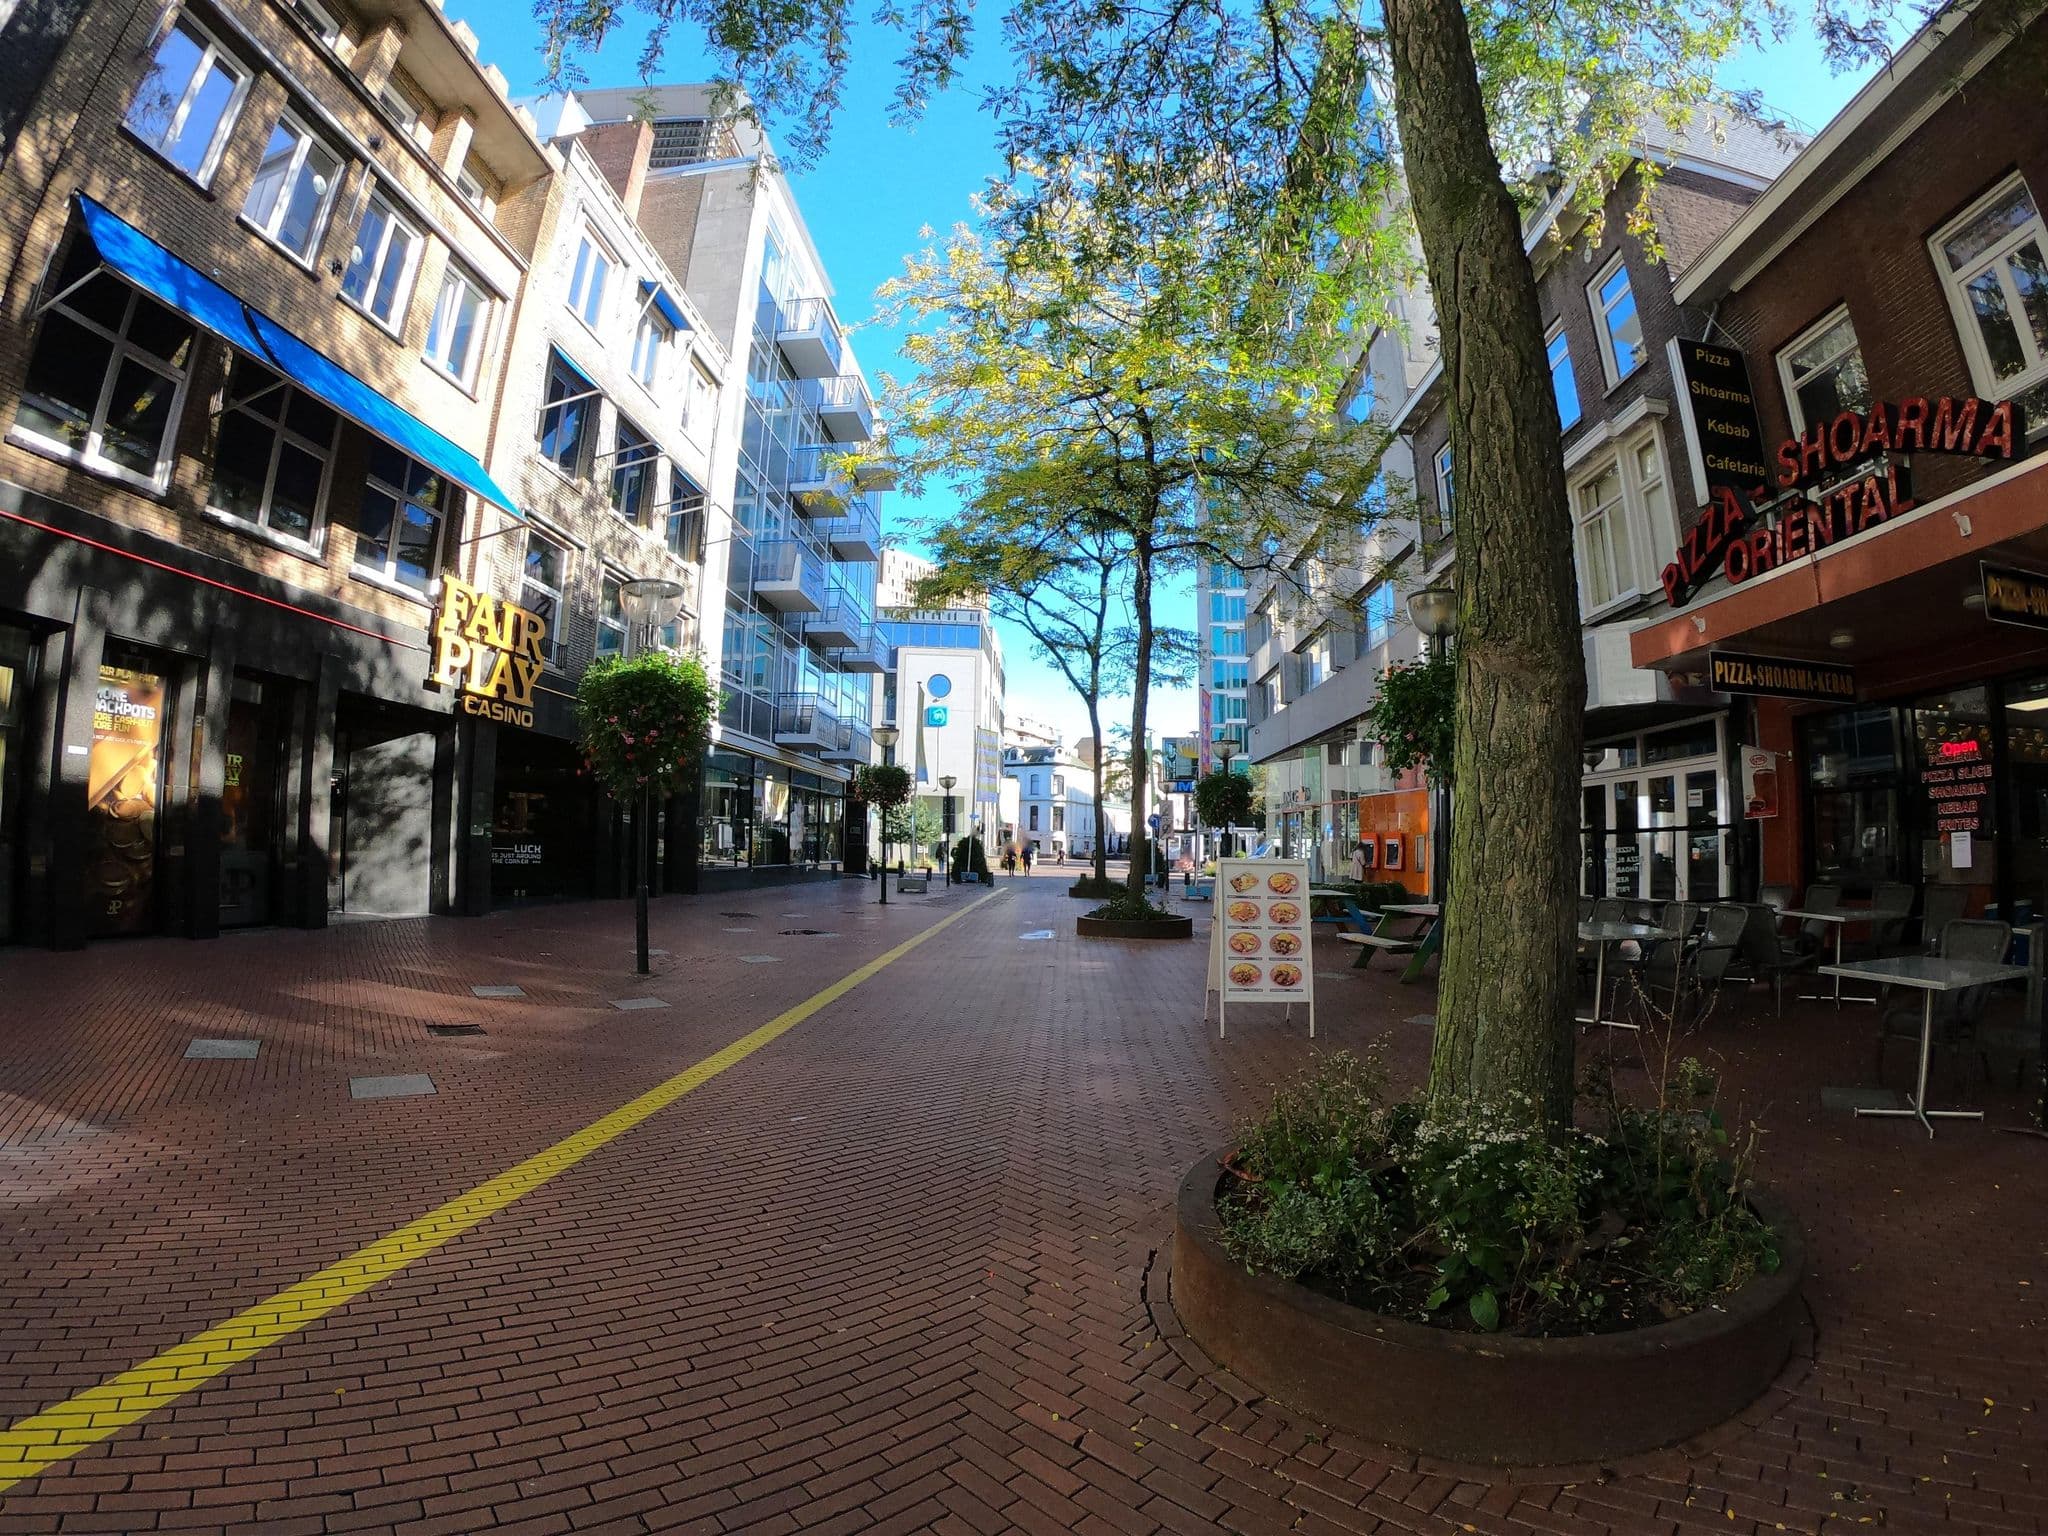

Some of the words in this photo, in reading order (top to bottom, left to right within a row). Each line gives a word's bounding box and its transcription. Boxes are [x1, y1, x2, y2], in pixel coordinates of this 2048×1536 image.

[1695, 348, 1731, 367] Pizza
[1690, 380, 1751, 404] Shoarma
[1707, 418, 1750, 438] Kebab
[1706, 454, 1766, 477] Cafetaria
[1660, 486, 1745, 607] PIZZA
[1776, 395, 2014, 488] SHOARMA
[439, 574, 546, 665] FAIR
[433, 629, 545, 708] PLAY
[464, 695, 534, 728] CASINO
[1943, 740, 1978, 757] Open
[1957, 764, 1993, 780] SLICE
[1928, 782, 1988, 799] SHOARMA
[1937, 800, 1978, 815] KEBAB
[1937, 817, 1981, 831] FRITES
[514, 844, 542, 854] LUCK
